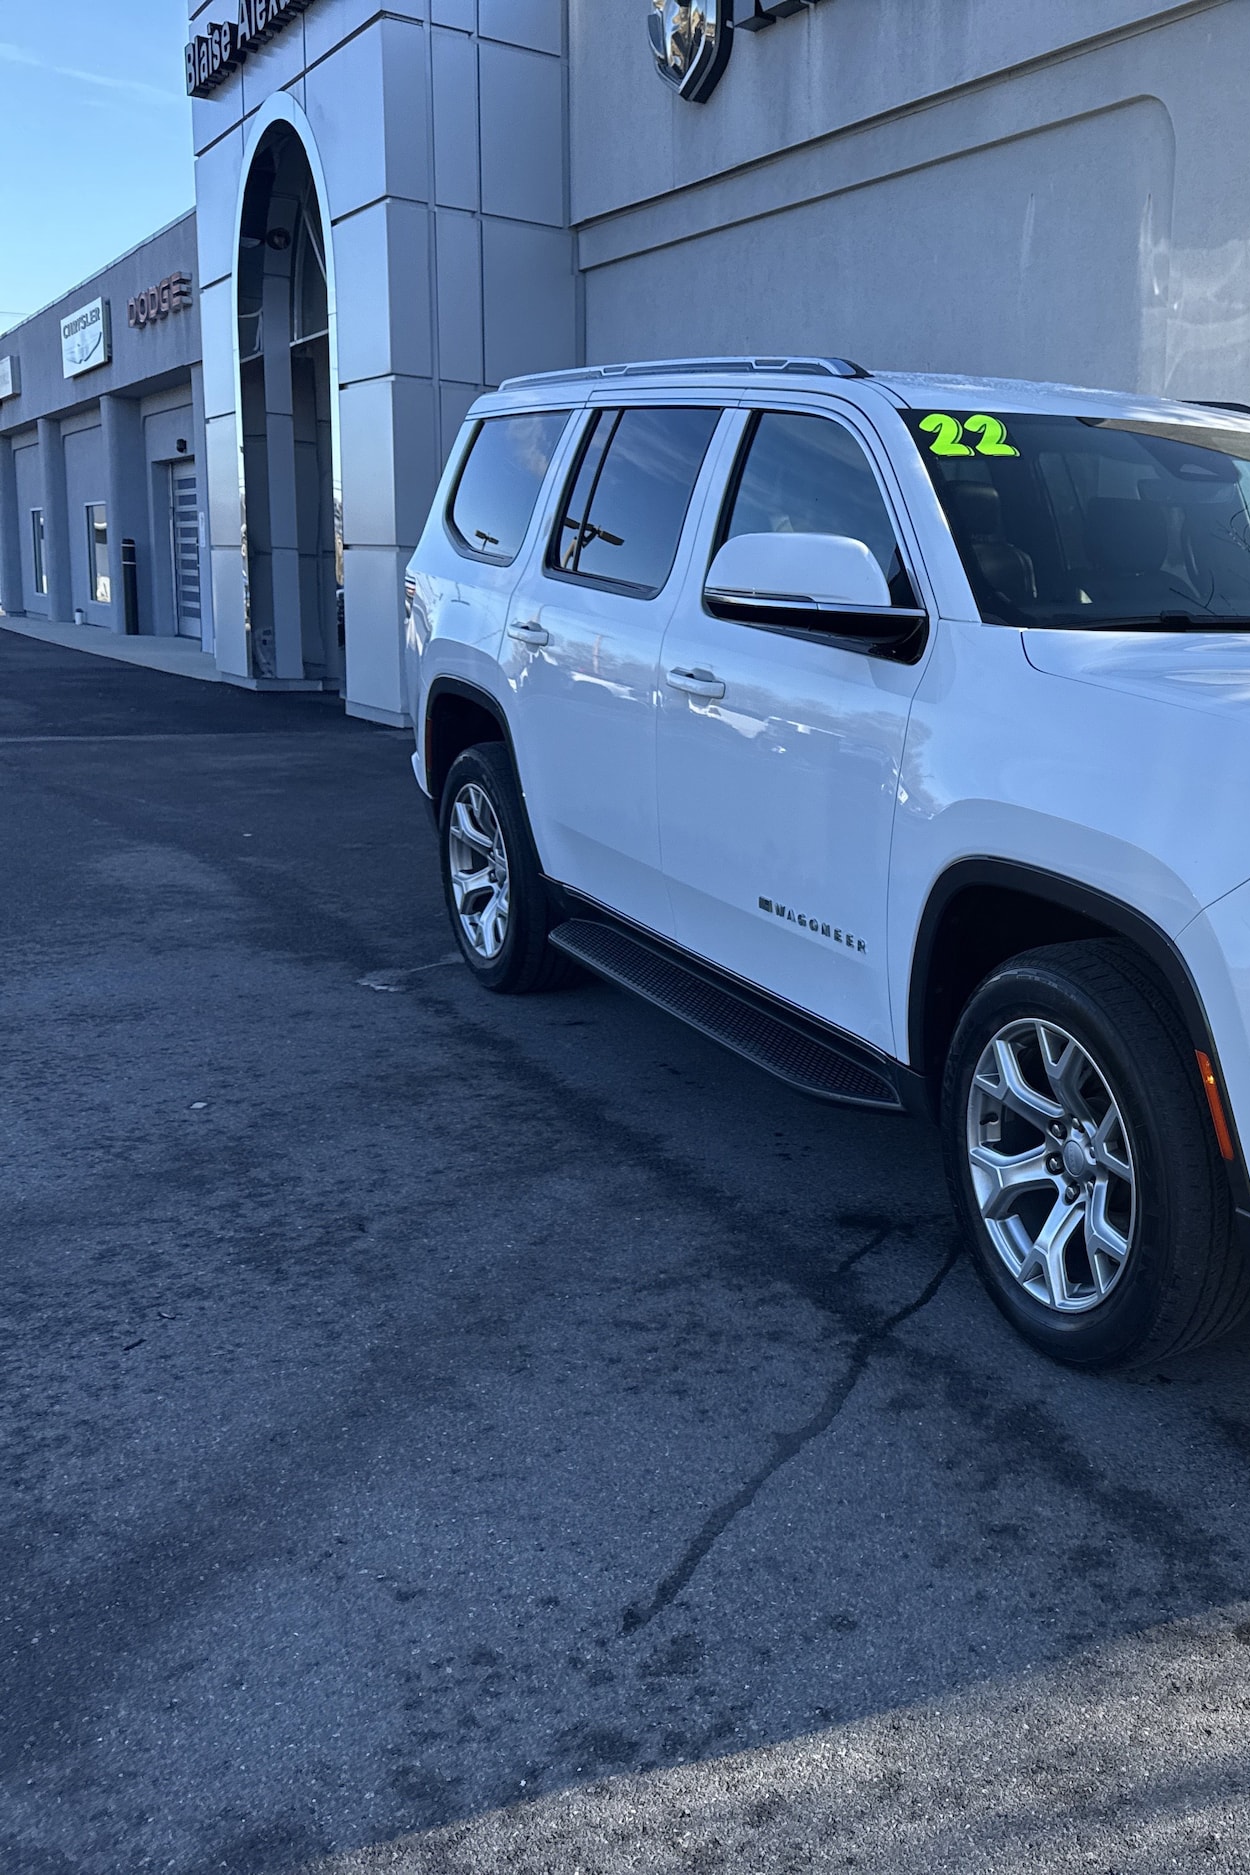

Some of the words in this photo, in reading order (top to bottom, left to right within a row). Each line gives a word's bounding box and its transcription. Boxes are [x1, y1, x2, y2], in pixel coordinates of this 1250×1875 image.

[185, 21, 232, 97] Blaise
[63, 307, 101, 340] CHRYSLER
[127, 271, 192, 329] DODGE
[918, 413, 1021, 457] 22
[775, 902, 868, 954] WAGONEER
